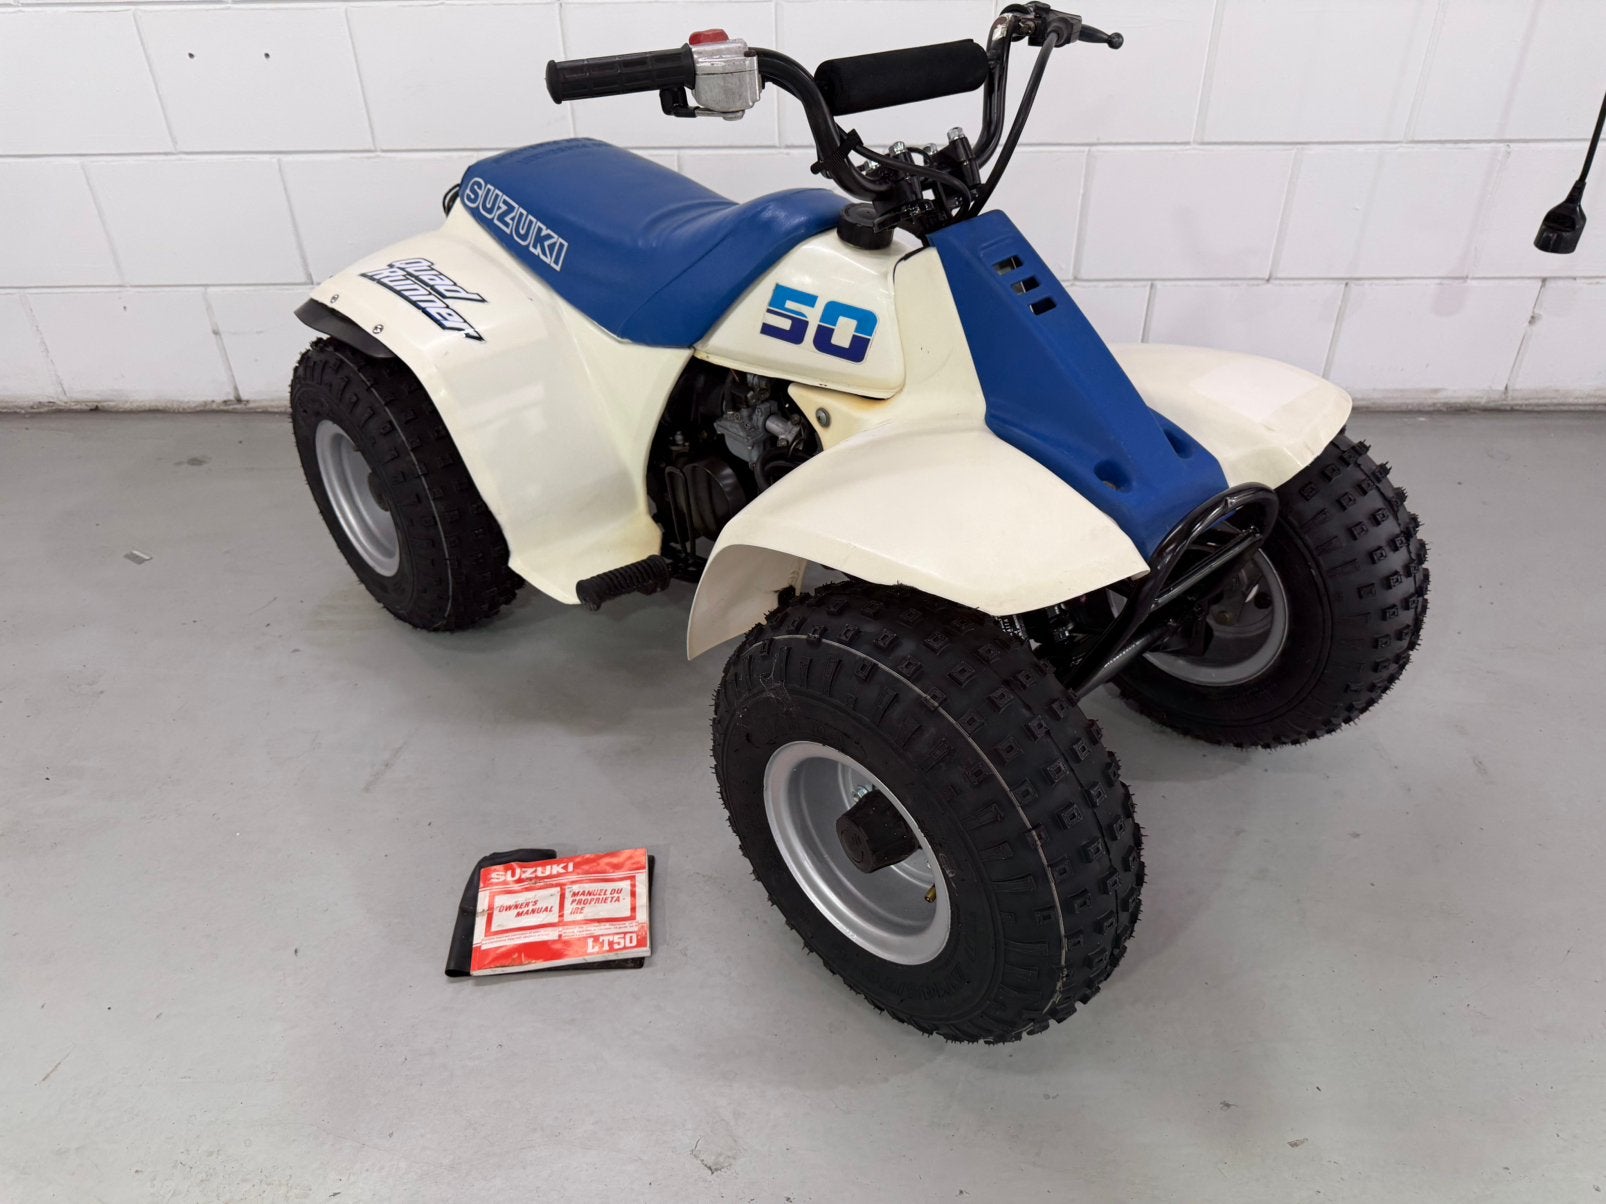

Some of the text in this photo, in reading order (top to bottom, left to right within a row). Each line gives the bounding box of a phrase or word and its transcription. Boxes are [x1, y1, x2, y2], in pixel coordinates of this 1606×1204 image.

[463, 177, 568, 272] SUZUKI
[387, 258, 488, 303] Quad
[359, 267, 485, 342] Runner
[760, 283, 878, 363] 50
[490, 862, 574, 882] SUZUKI
[571, 887, 624, 898] MANUEL DU
[498, 899, 539, 913] OWNER'S
[514, 905, 554, 918] MANUAL
[587, 932, 637, 953] LT50
